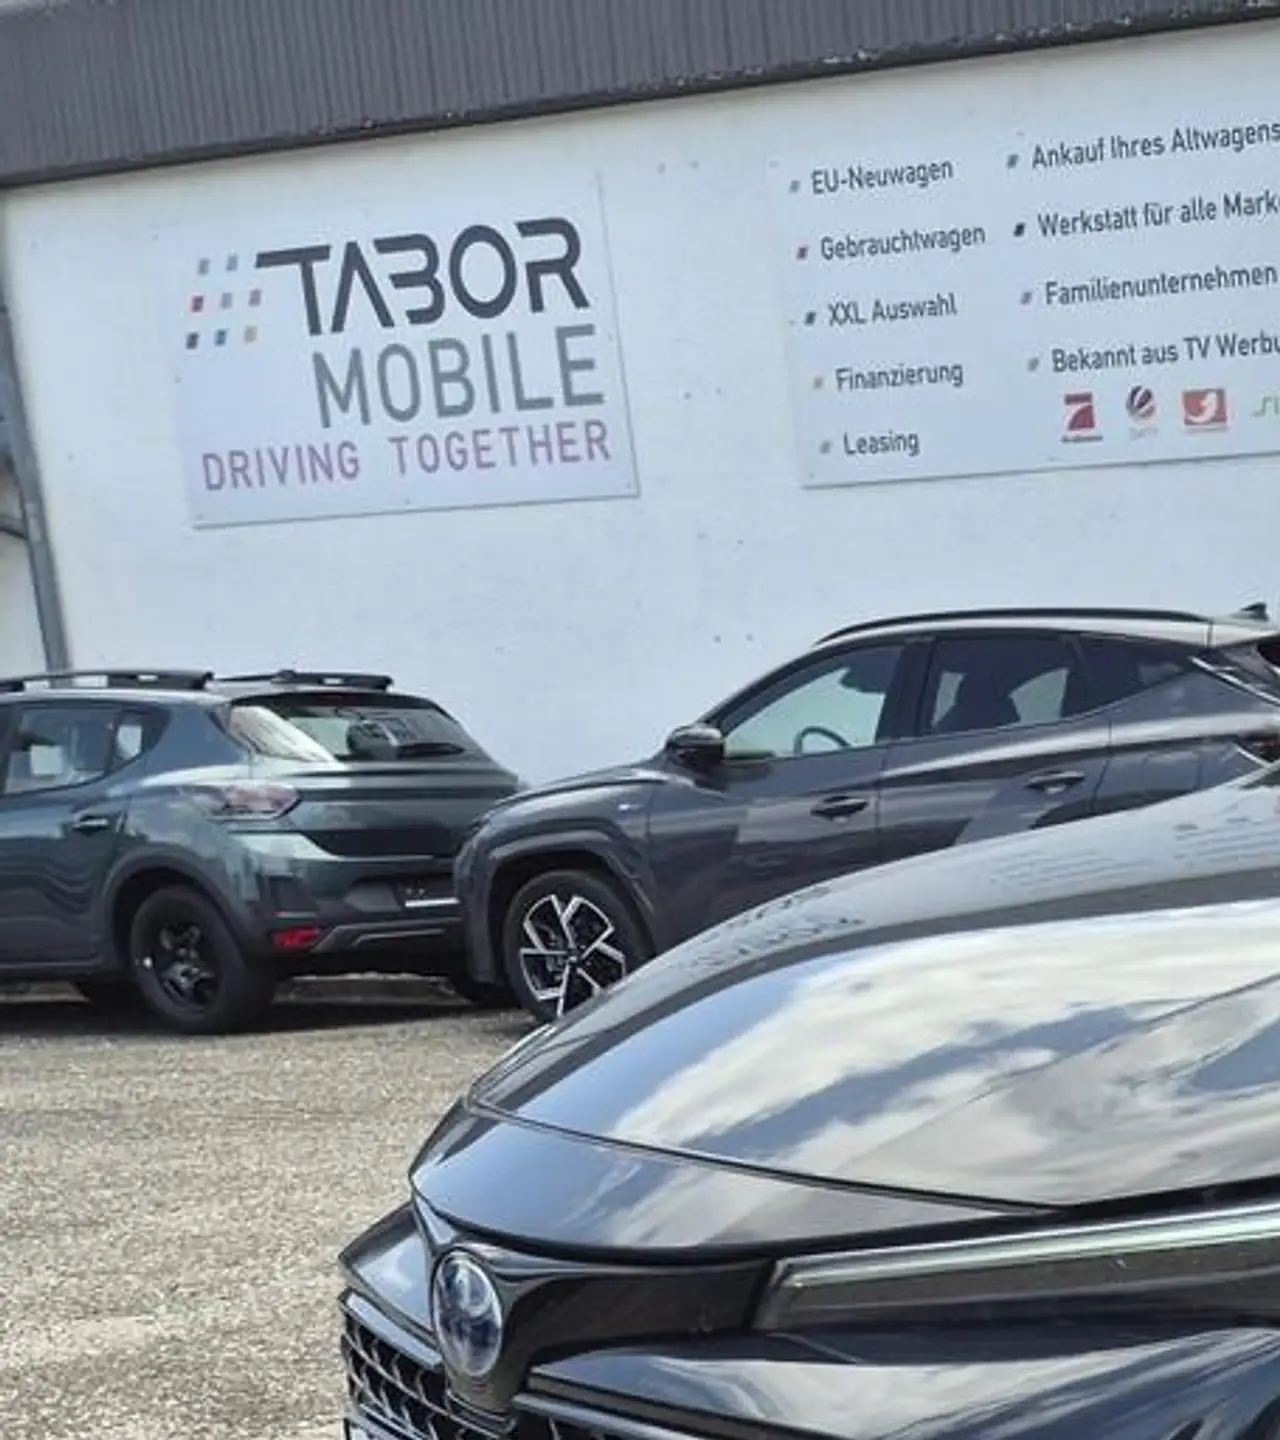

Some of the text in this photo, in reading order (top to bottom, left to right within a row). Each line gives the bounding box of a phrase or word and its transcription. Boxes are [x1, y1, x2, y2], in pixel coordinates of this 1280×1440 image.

[1032, 135, 1106, 170] Ankauf
[1111, 133, 1165, 161] Ihres
[811, 158, 954, 195] EU-Neuwagen
[1038, 207, 1138, 238] Werkstatt
[1143, 203, 1173, 227] für
[1180, 197, 1217, 224] alle
[820, 224, 986, 261] Gebrauchtwagen
[254, 217, 590, 337] TABOR
[1046, 264, 1278, 306] Familienunternehmen
[828, 293, 957, 326] XXL Auswahl
[1052, 347, 1138, 373] Bekannt
[1142, 345, 1178, 366] aus
[1184, 336, 1211, 361] TV
[312, 323, 605, 428] MOBILE
[835, 362, 963, 392] Finanzierung
[202, 419, 612, 491] DRIVING TOGETHER
[843, 431, 920, 456] Leasing
